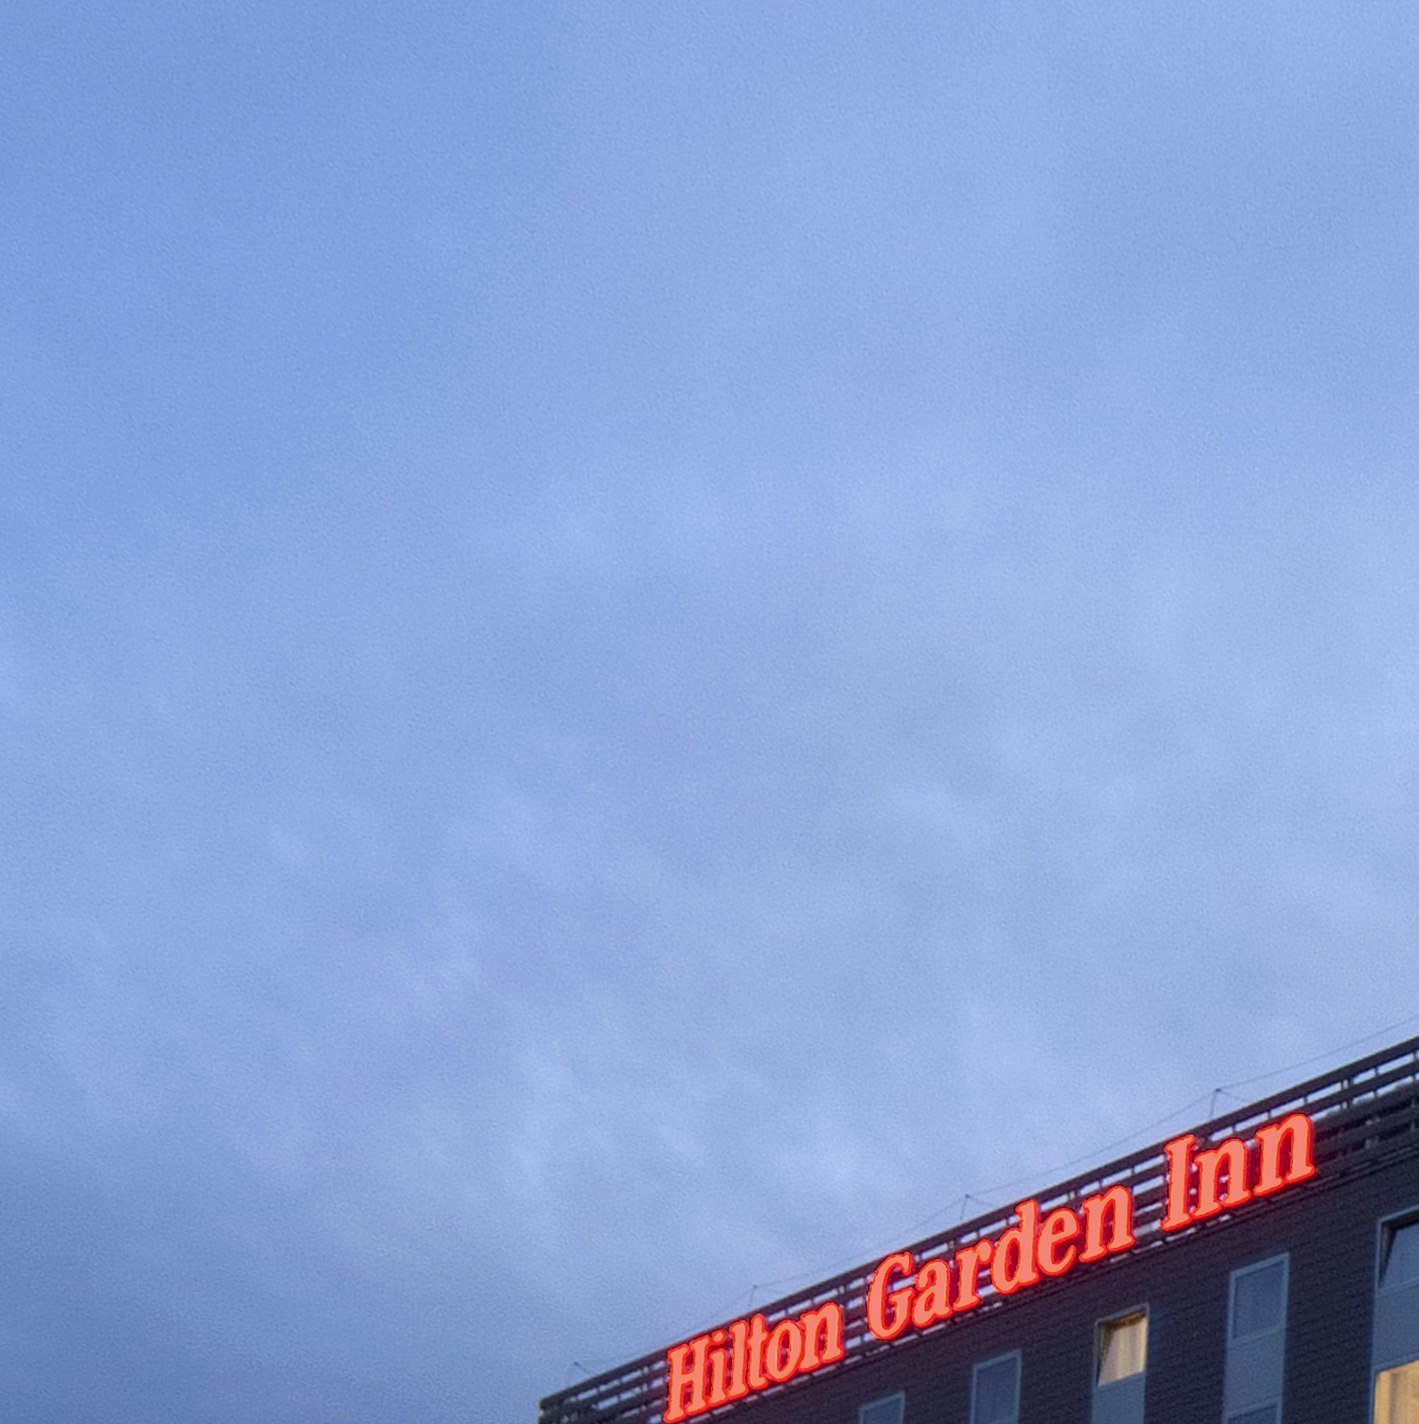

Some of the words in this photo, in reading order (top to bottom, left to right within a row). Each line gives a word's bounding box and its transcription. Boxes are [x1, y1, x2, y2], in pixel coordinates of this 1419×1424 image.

[664, 1302, 843, 1424] Hilton
[866, 1184, 1135, 1340] Garden
[1160, 1112, 1315, 1232] Inn
